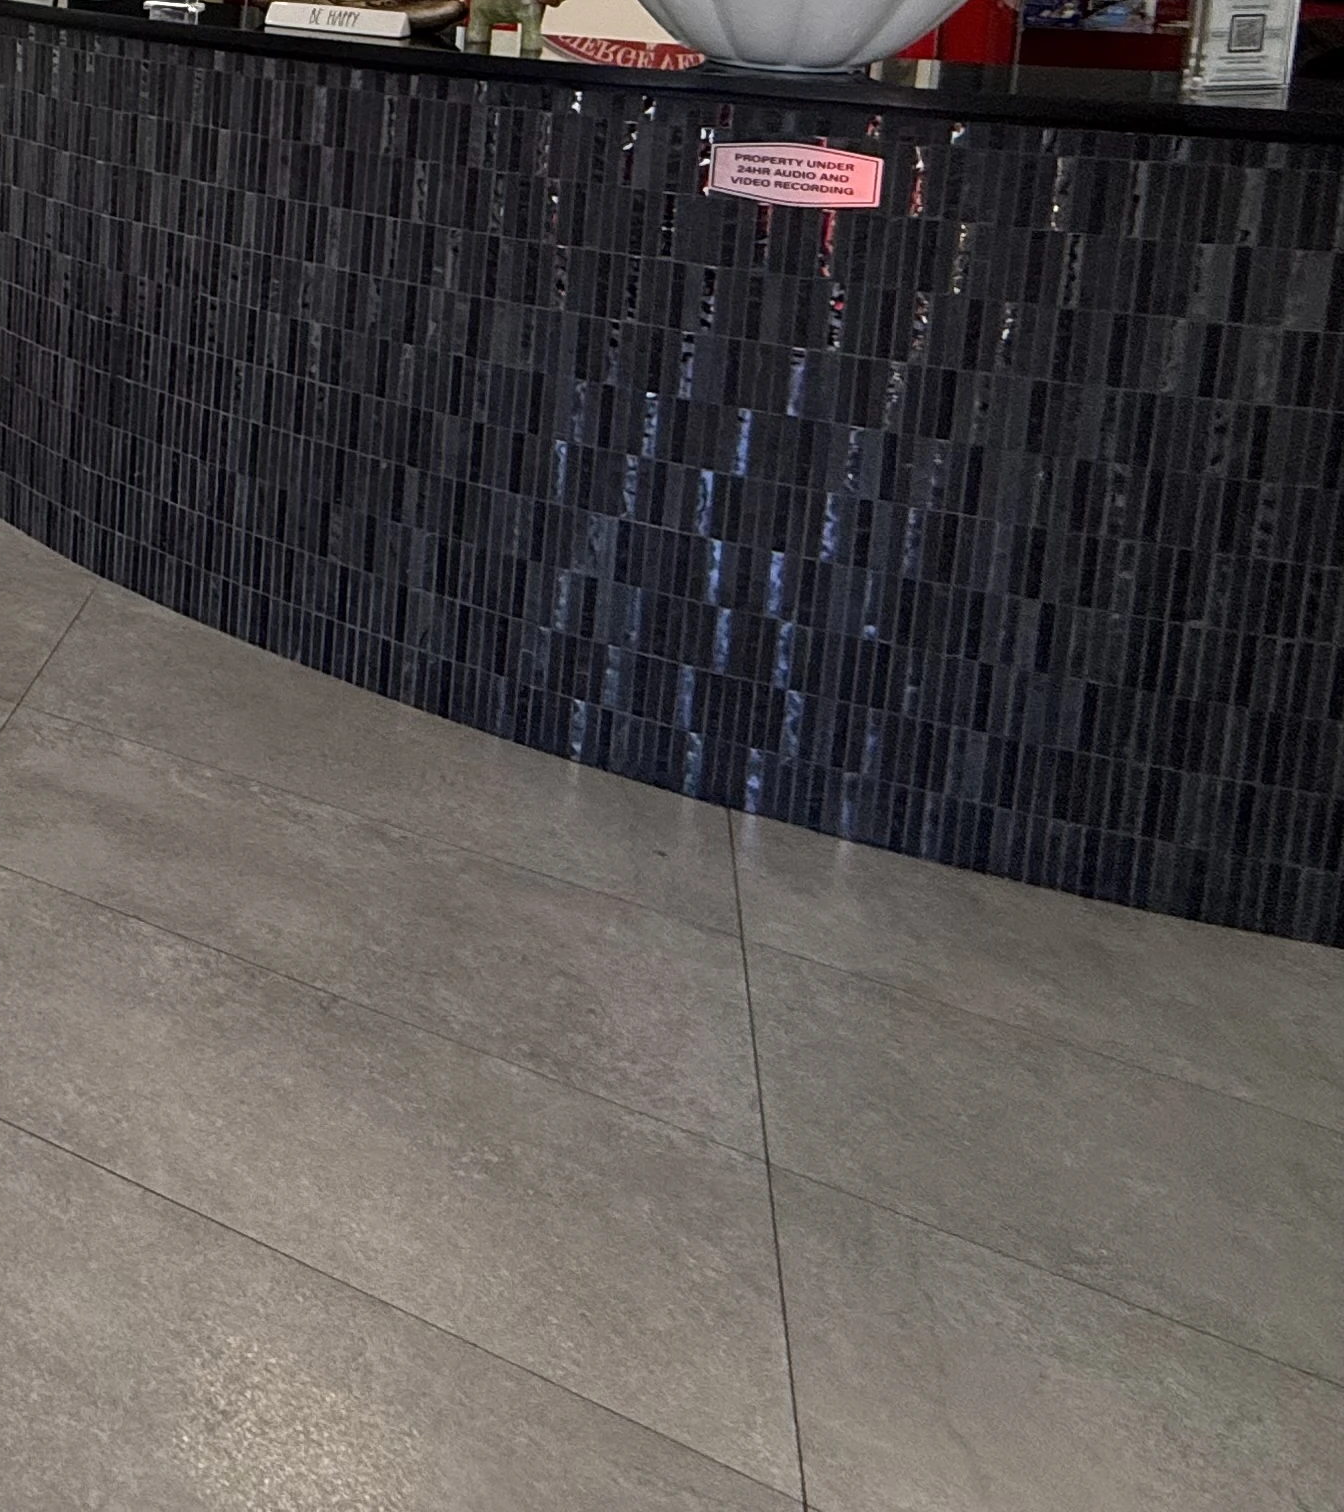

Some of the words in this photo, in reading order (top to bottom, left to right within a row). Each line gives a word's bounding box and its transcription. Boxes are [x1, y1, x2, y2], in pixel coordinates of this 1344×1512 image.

[326, 9, 362, 29] HAPPY
[734, 153, 803, 167] PROPERTY
[806, 160, 856, 172] UNDER
[737, 164, 771, 177] 24HR
[774, 168, 817, 181] AUDIO
[820, 173, 850, 184] AND
[729, 176, 771, 188] VIDEO
[773, 181, 855, 196] RECORDING
